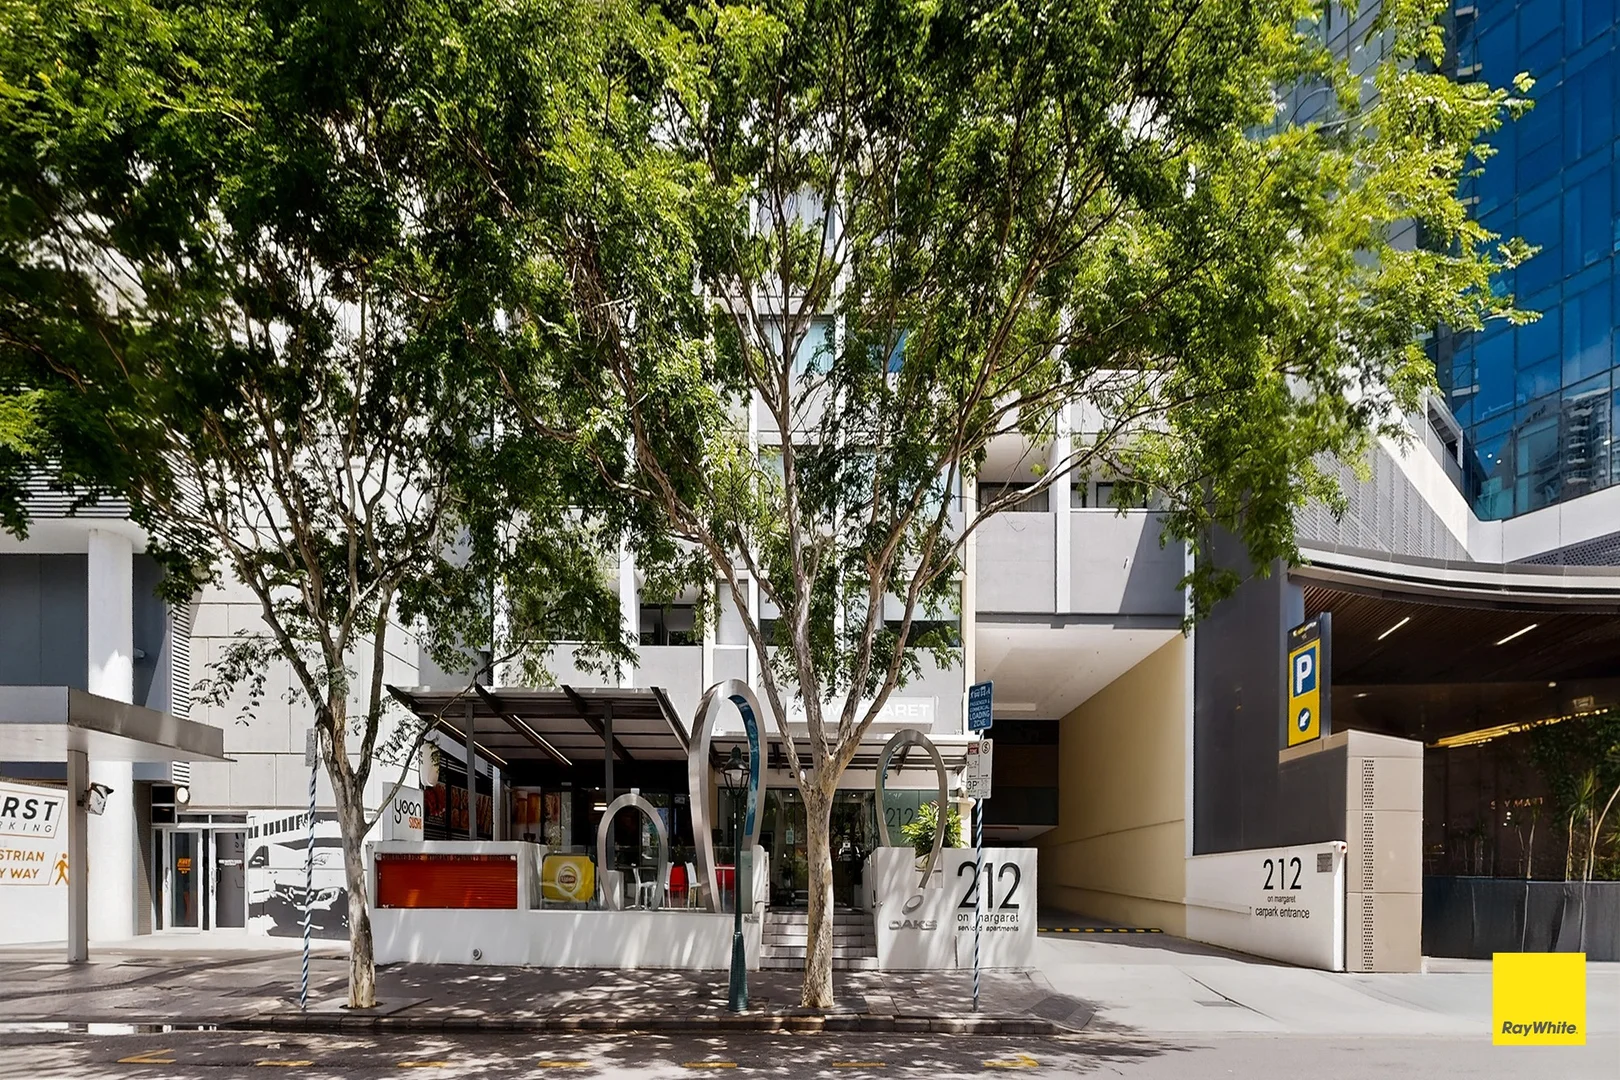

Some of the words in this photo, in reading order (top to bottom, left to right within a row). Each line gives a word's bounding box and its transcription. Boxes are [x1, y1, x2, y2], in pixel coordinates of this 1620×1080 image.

[1296, 654, 1312, 693] P
[827, 704, 930, 717] MRARET
[970, 710, 990, 720] LOADING
[394, 798, 421, 824] yoon
[886, 808, 913, 827] 212
[10, 868, 39, 879] WAY
[1263, 857, 1302, 890] 212
[957, 861, 1021, 909] 212
[1275, 895, 1296, 904] margaret
[1255, 907, 1279, 918] carpark
[1280, 907, 1310, 919] entrance
[889, 919, 938, 930] OAKS
